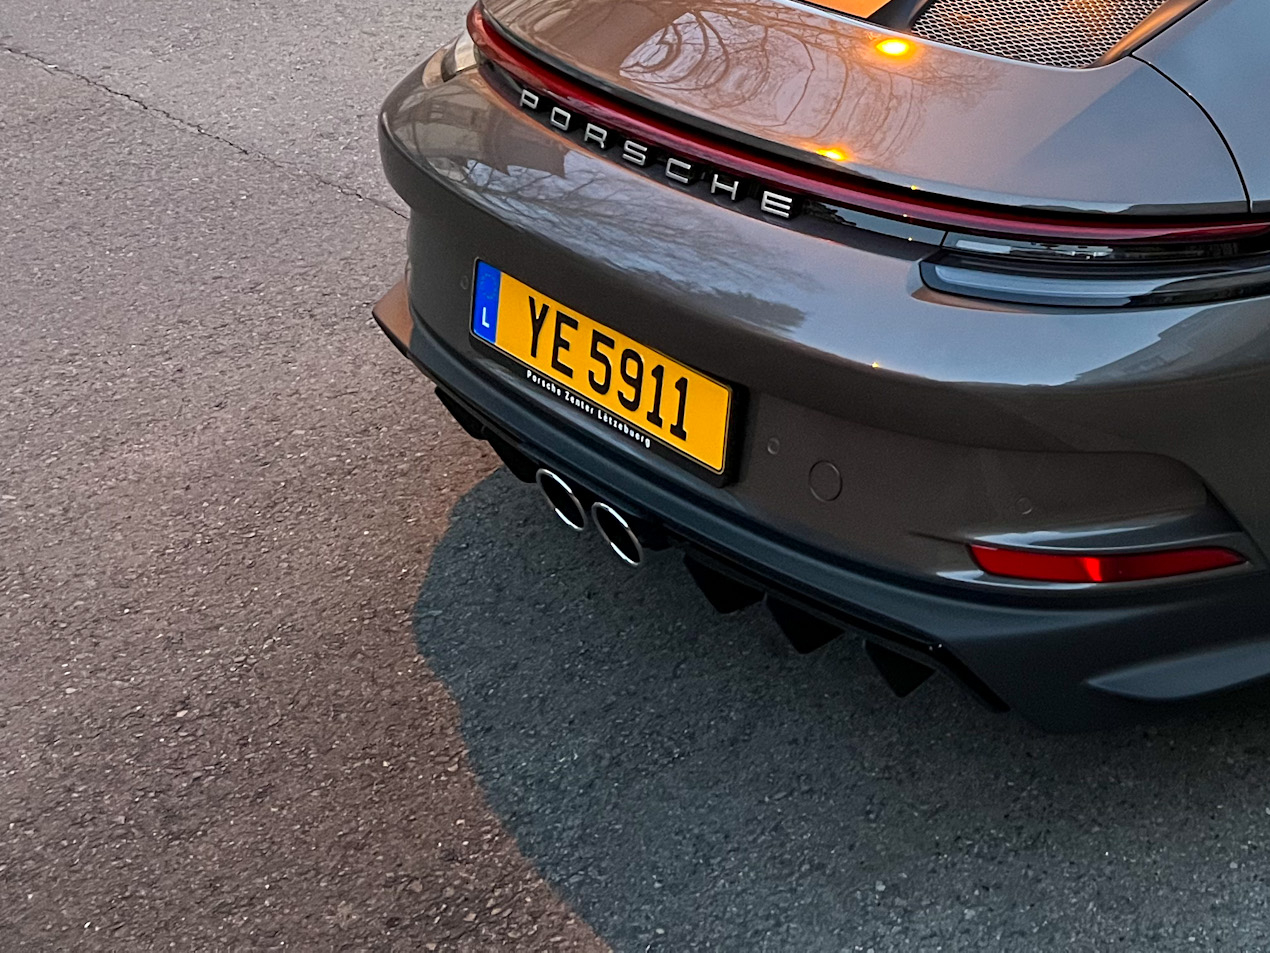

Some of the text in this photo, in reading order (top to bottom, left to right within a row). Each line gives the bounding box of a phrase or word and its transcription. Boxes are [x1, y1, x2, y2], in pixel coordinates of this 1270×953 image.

[519, 88, 793, 220] PORSCHE
[481, 306, 490, 329] L
[526, 368, 563, 398] Porsche
[564, 390, 596, 416] Zenter
